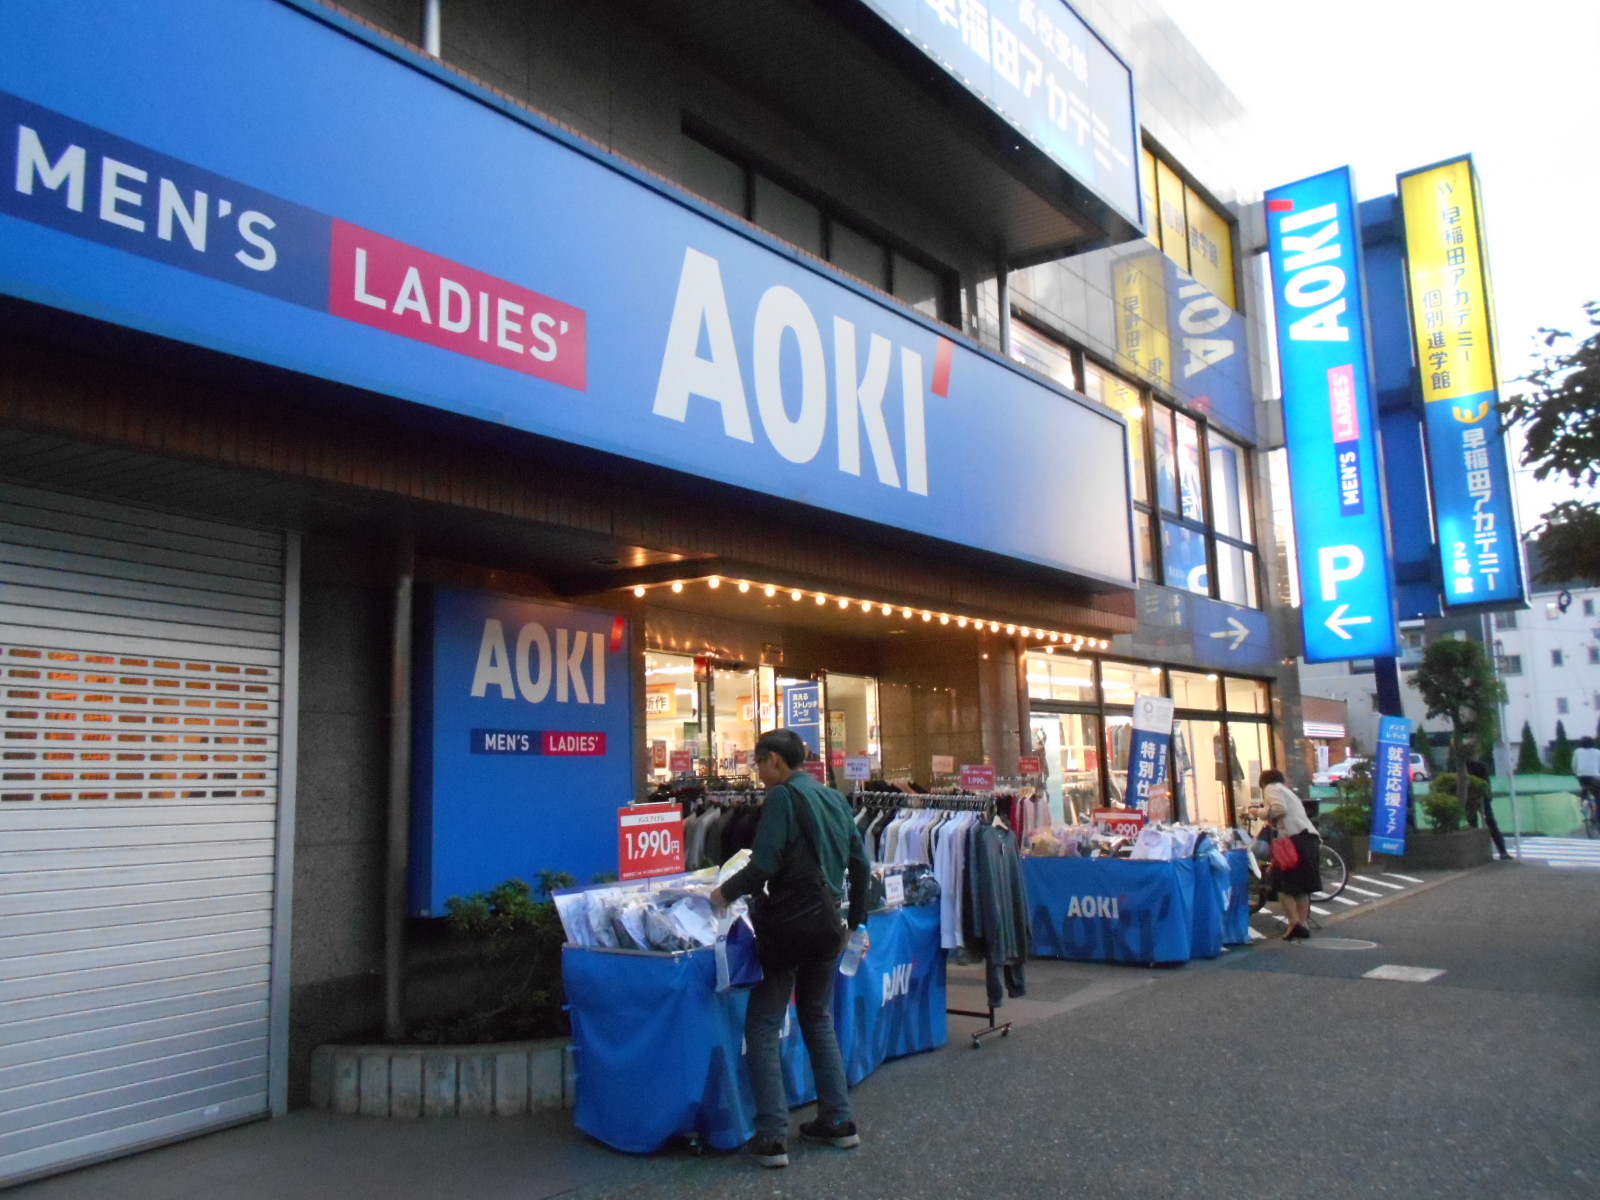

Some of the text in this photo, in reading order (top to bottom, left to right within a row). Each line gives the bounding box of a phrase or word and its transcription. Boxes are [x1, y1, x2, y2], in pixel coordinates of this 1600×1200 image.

[15, 124, 278, 272] MEN'S
[353, 247, 570, 363] LADIES'
[1280, 202, 1350, 342] AOKI
[1442, 205, 1474, 361] 早稲田アカデミー
[651, 246, 929, 497] AOKI
[1422, 288, 1451, 391] 個別進学館
[1339, 451, 1360, 506] MEN'S
[1461, 427, 1500, 592] 早稲田アカデミー
[1317, 544, 1365, 601] P
[470, 618, 606, 704] AOKI
[485, 733, 599, 752] MEN'S LADIES'
[1067, 895, 1119, 919] AOKI
